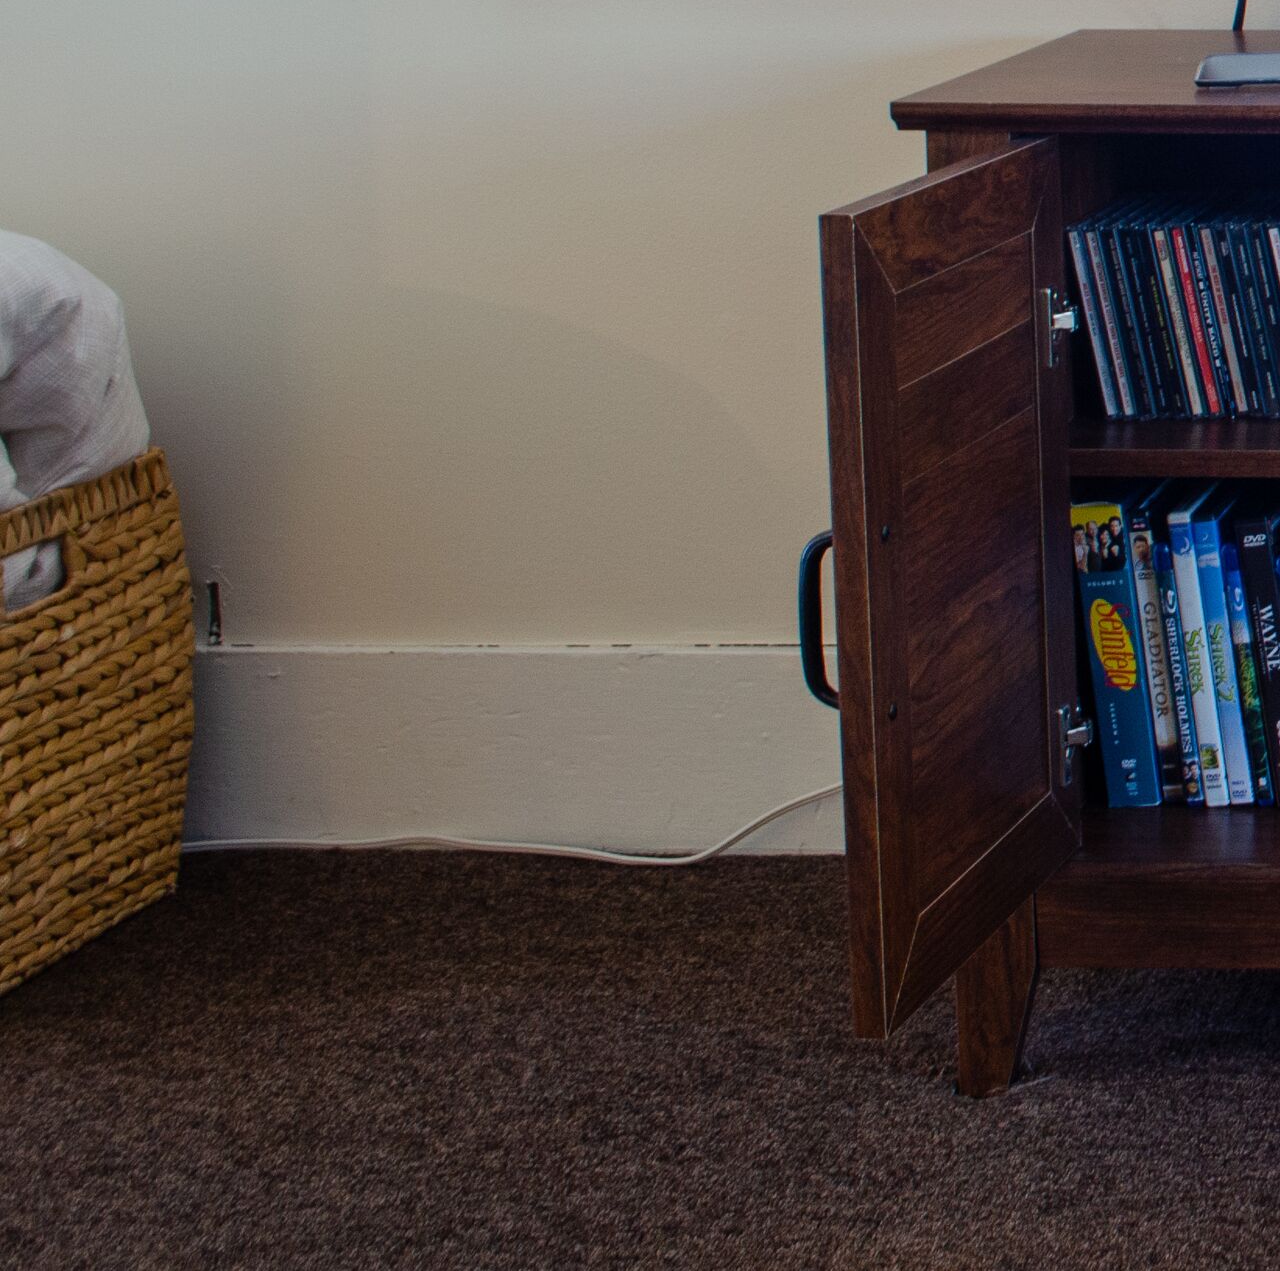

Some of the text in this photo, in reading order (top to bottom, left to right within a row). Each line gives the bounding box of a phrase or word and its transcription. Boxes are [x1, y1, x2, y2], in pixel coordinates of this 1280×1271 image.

[1143, 602, 1170, 718] GLADIATOR
[1165, 617, 1193, 753] SHERLOCK HOLMES
[1258, 603, 1280, 671] WAYNE
